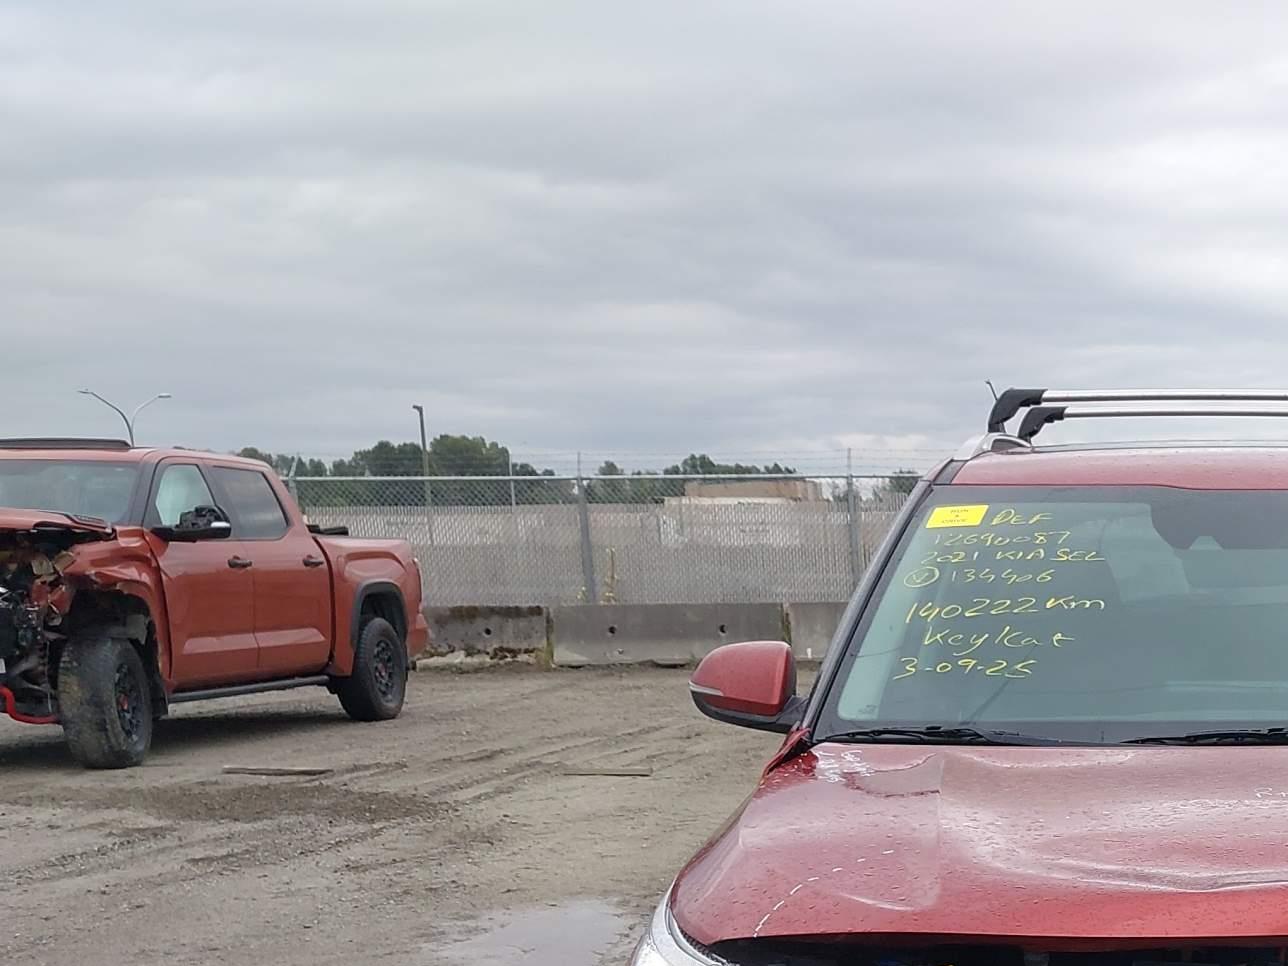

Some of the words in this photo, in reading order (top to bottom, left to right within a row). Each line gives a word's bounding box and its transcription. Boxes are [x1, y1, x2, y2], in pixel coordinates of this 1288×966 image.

[934, 530, 1072, 546] 12690087
[920, 551, 979, 565] 2021
[995, 549, 1045, 561] KIA
[904, 597, 1039, 623] 140222
[893, 657, 1038, 680] 3-09-25
